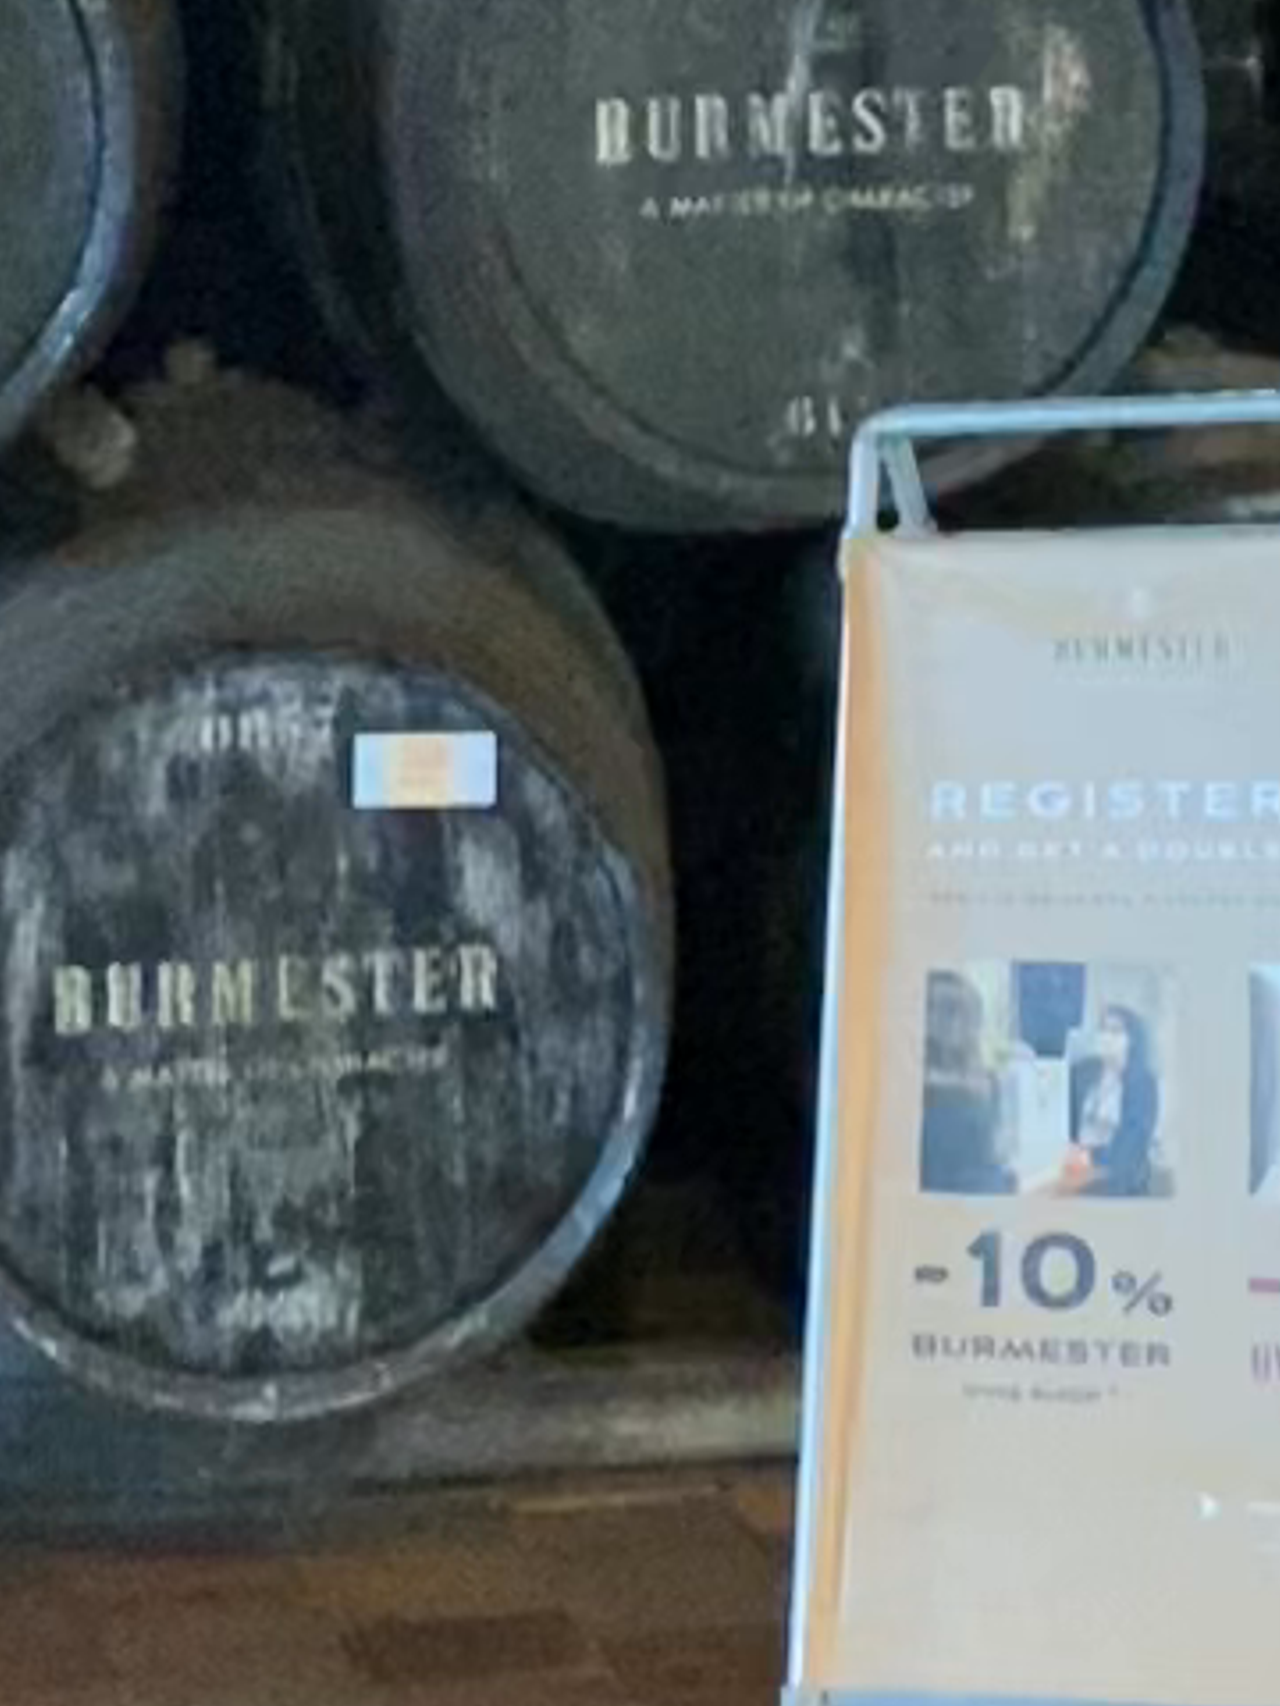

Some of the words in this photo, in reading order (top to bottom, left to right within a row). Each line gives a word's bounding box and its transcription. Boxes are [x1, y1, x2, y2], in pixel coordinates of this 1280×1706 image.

[594, 84, 1025, 165] BURMESTER
[639, 196, 660, 220] A
[52, 942, 498, 1036] BURMESTER
[911, 1334, 1171, 1368] BURMESTER
